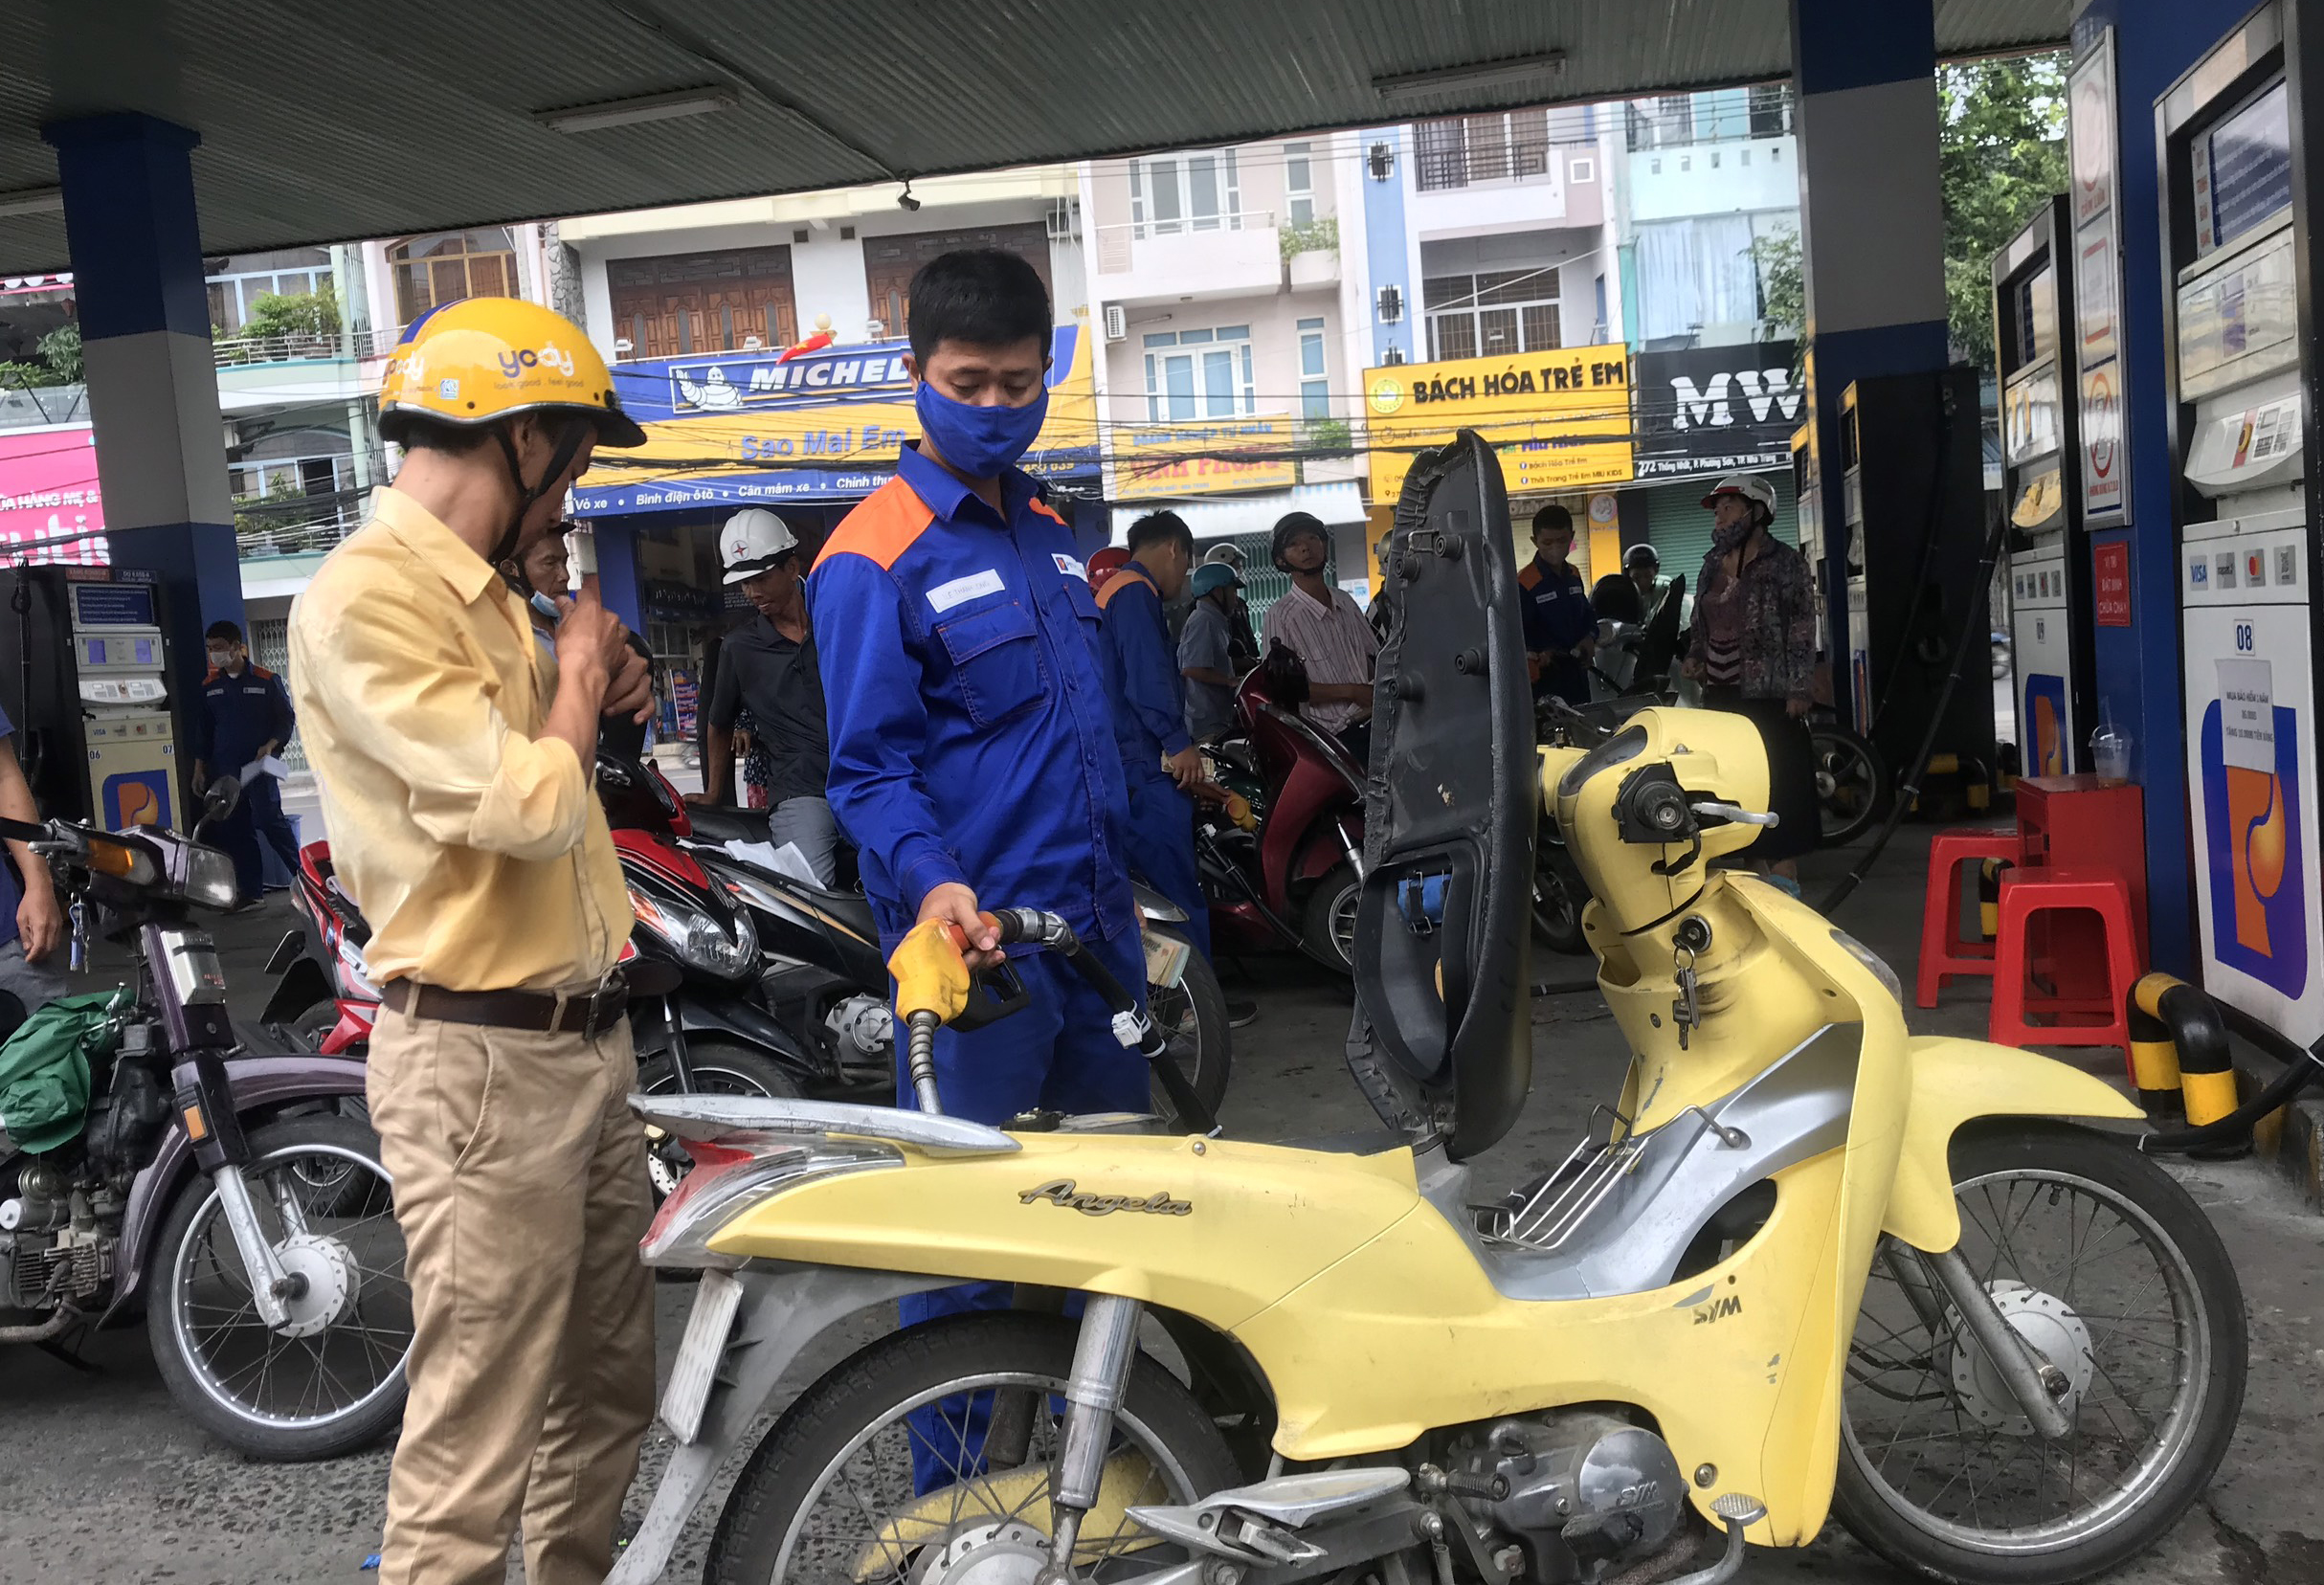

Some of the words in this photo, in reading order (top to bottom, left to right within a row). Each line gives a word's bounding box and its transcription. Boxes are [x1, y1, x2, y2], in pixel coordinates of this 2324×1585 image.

[498, 342, 574, 378] yody
[749, 357, 910, 391] MICHEL
[1413, 372, 1476, 403] BÁCH
[1484, 365, 1535, 396] HÓA
[1540, 357, 1583, 392] TRẺ
[1591, 362, 1624, 386] EM
[740, 435, 793, 459] Sao
[803, 428, 851, 456] Mai
[862, 425, 905, 449] Em
[1638, 460, 1657, 477] 272
[593, 500, 608, 509] xe
[795, 482, 811, 493] xe
[2190, 565, 2207, 583] VISA
[2236, 624, 2253, 652] 08
[89, 750, 101, 760] 06
[162, 746, 172, 754] 07
[1018, 1178, 1193, 1217] Angela
[1693, 1294, 1742, 1326] SYM
